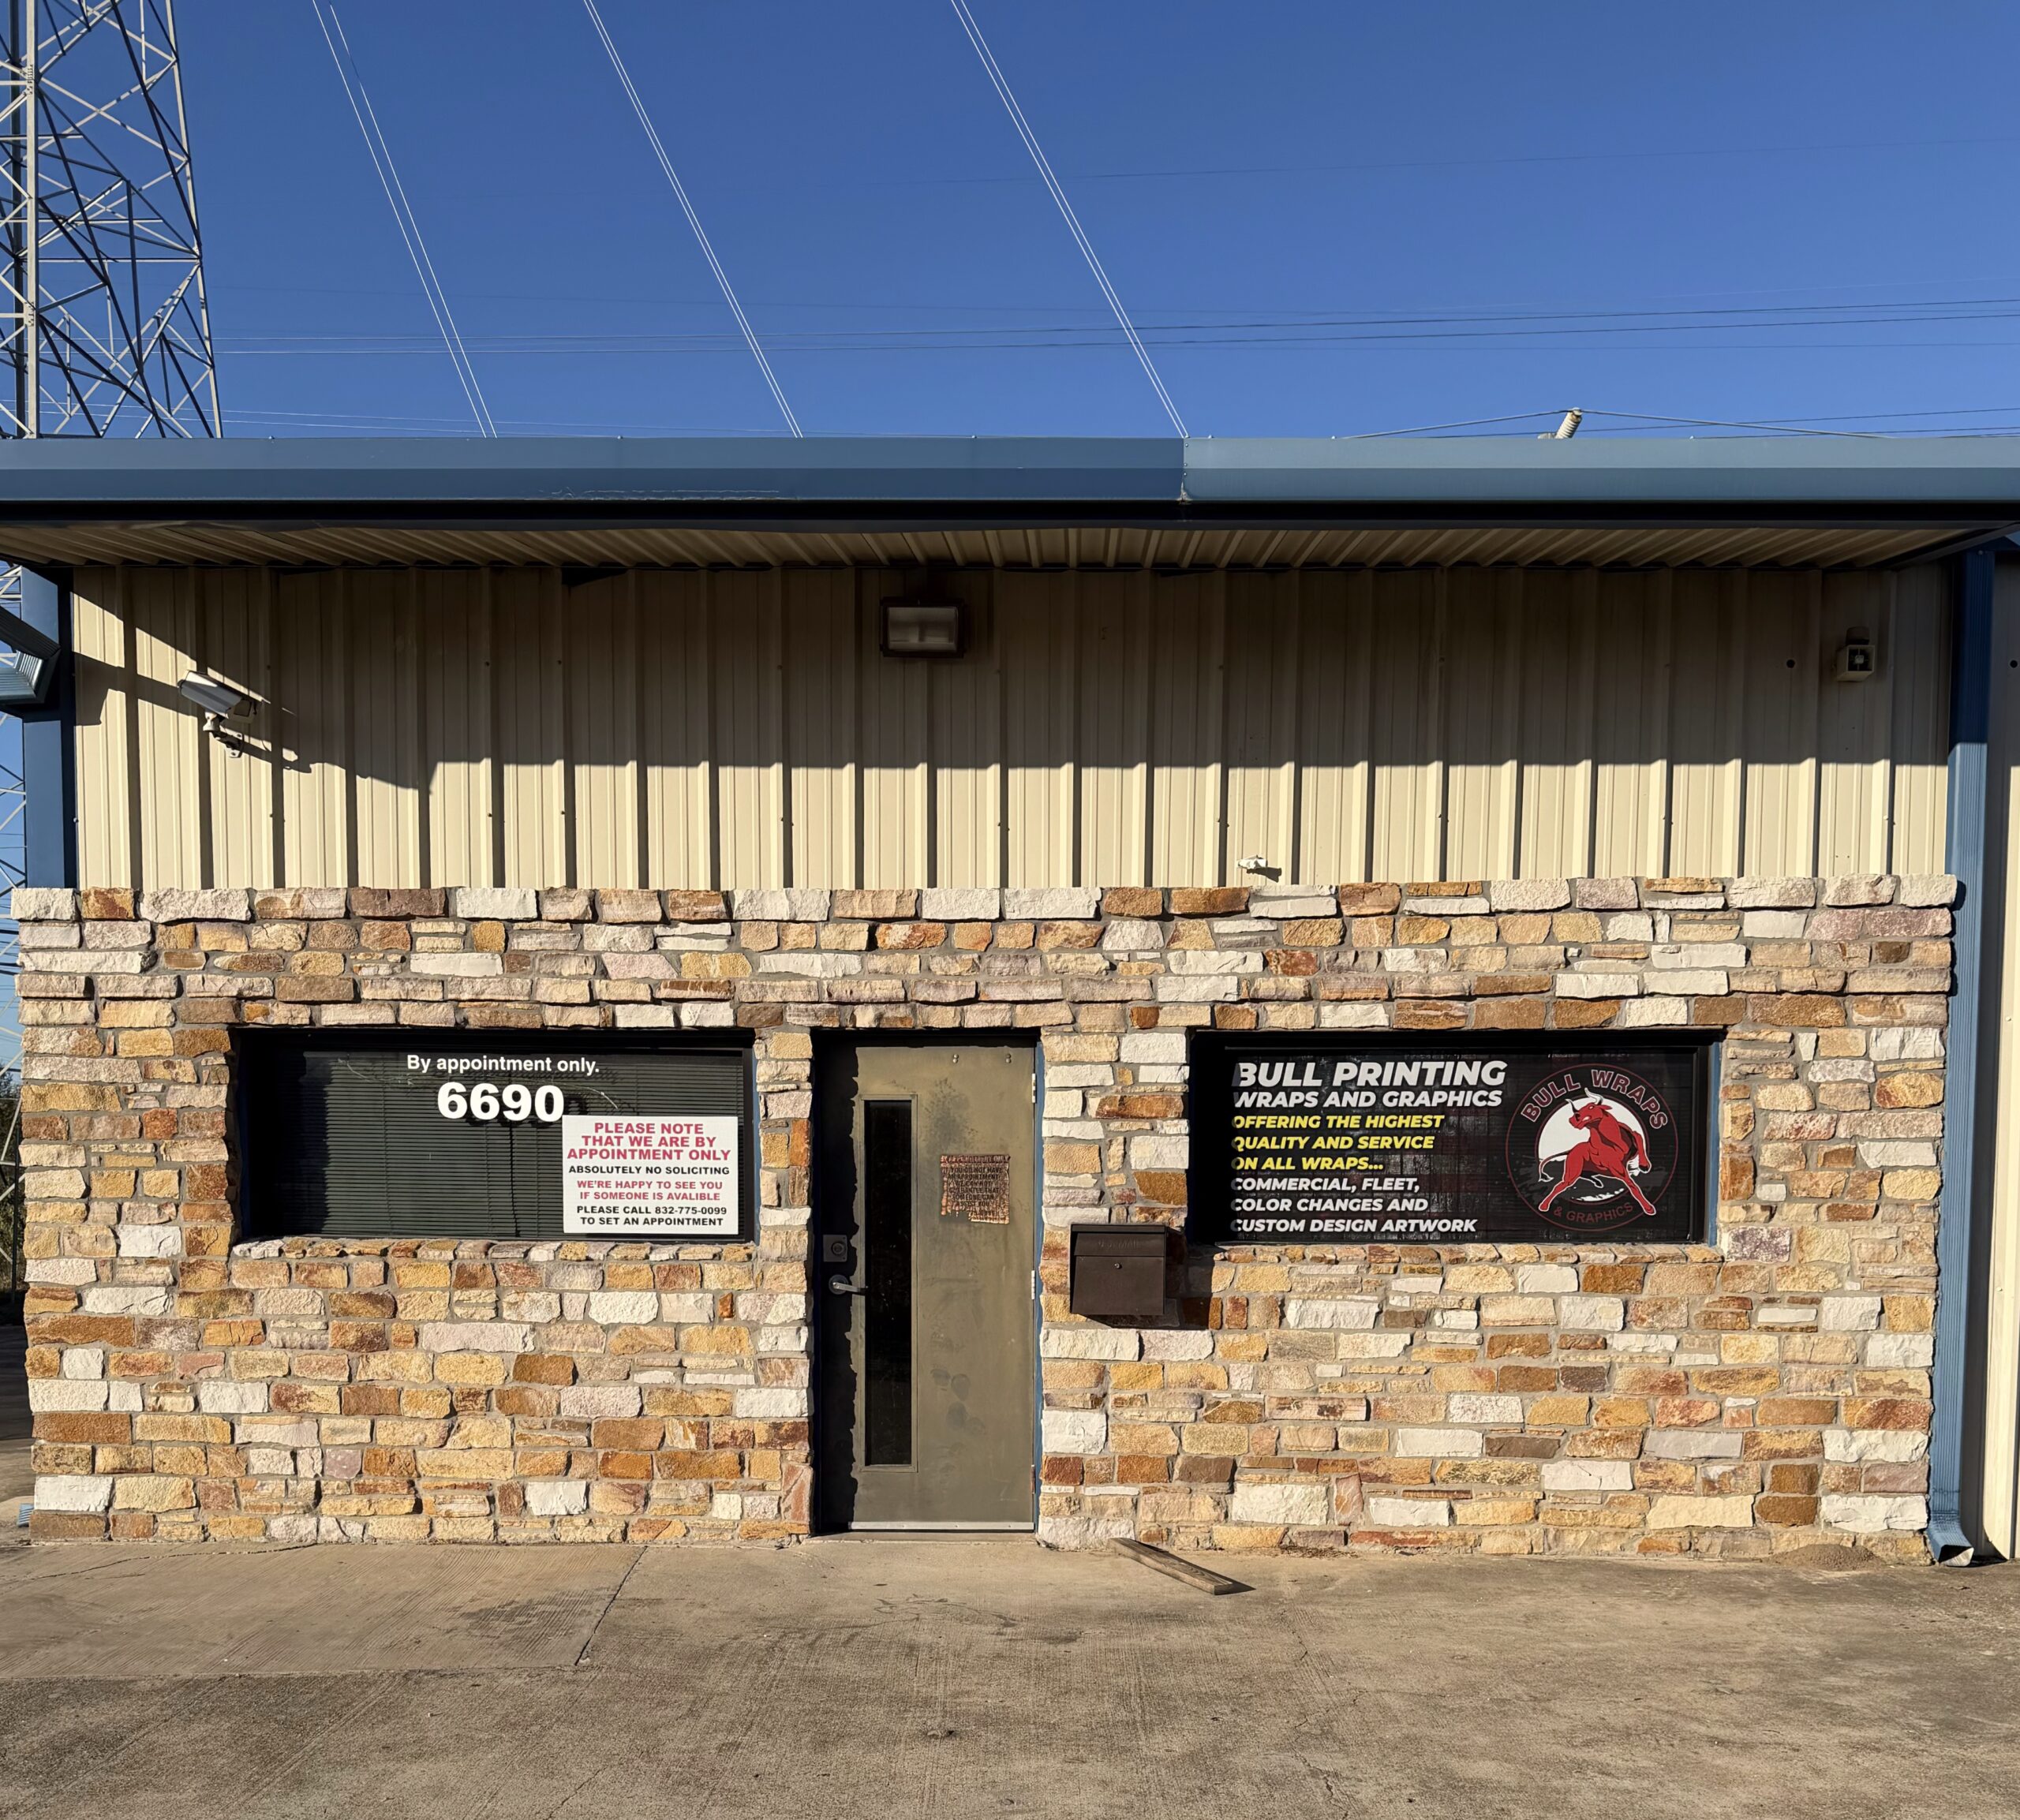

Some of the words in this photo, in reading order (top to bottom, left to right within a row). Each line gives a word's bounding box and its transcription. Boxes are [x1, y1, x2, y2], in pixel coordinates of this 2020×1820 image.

[408, 1055, 431, 1073] By
[437, 1056, 552, 1073] appointment
[558, 1058, 599, 1075] only.
[1231, 1061, 1322, 1088] BULL
[1333, 1060, 1507, 1087] PRINTING
[437, 1082, 564, 1122] 6690
[1233, 1092, 1319, 1108] WRAPS
[1323, 1092, 1376, 1108] AND
[1382, 1090, 1502, 1107] GRAPHICS
[1521, 1074, 1580, 1122] BULL
[1592, 1070, 1667, 1129] WRAPS
[594, 1123, 656, 1134] PLEASE
[660, 1123, 703, 1134] NOTE
[1232, 1116, 1321, 1128] OFFERING
[1326, 1116, 1360, 1128] THE
[1365, 1115, 1444, 1127] HIGHEST
[582, 1136, 623, 1146] THAT
[629, 1136, 653, 1147] WE
[658, 1136, 690, 1148] ARE
[696, 1136, 716, 1148] BY
[1232, 1136, 1309, 1152] QUALITY
[1312, 1136, 1353, 1149] AND
[1358, 1136, 1435, 1149] SERVICE
[567, 1149, 684, 1160] APPOINTMENT
[689, 1149, 731, 1160] ONLY
[646, 1166, 662, 1175] NO
[666, 1166, 730, 1175] SOLICITING
[1232, 1157, 1259, 1170] ON
[1262, 1157, 1295, 1170] ALL
[1303, 1157, 1383, 1170] WRAPS...
[1232, 1178, 1356, 1193] COMMERCIAL,
[1362, 1178, 1420, 1193] FLEET,
[1231, 1198, 1292, 1211] COLOR
[1297, 1198, 1382, 1211] CHANGES
[1386, 1198, 1428, 1211] AND
[1554, 1206, 1562, 1216] &
[1566, 1203, 1633, 1223] GRAPHICS
[1230, 1219, 1305, 1232] CUSTOM
[1310, 1219, 1376, 1232] DESIGN
[1381, 1219, 1478, 1232] ARTWORK
